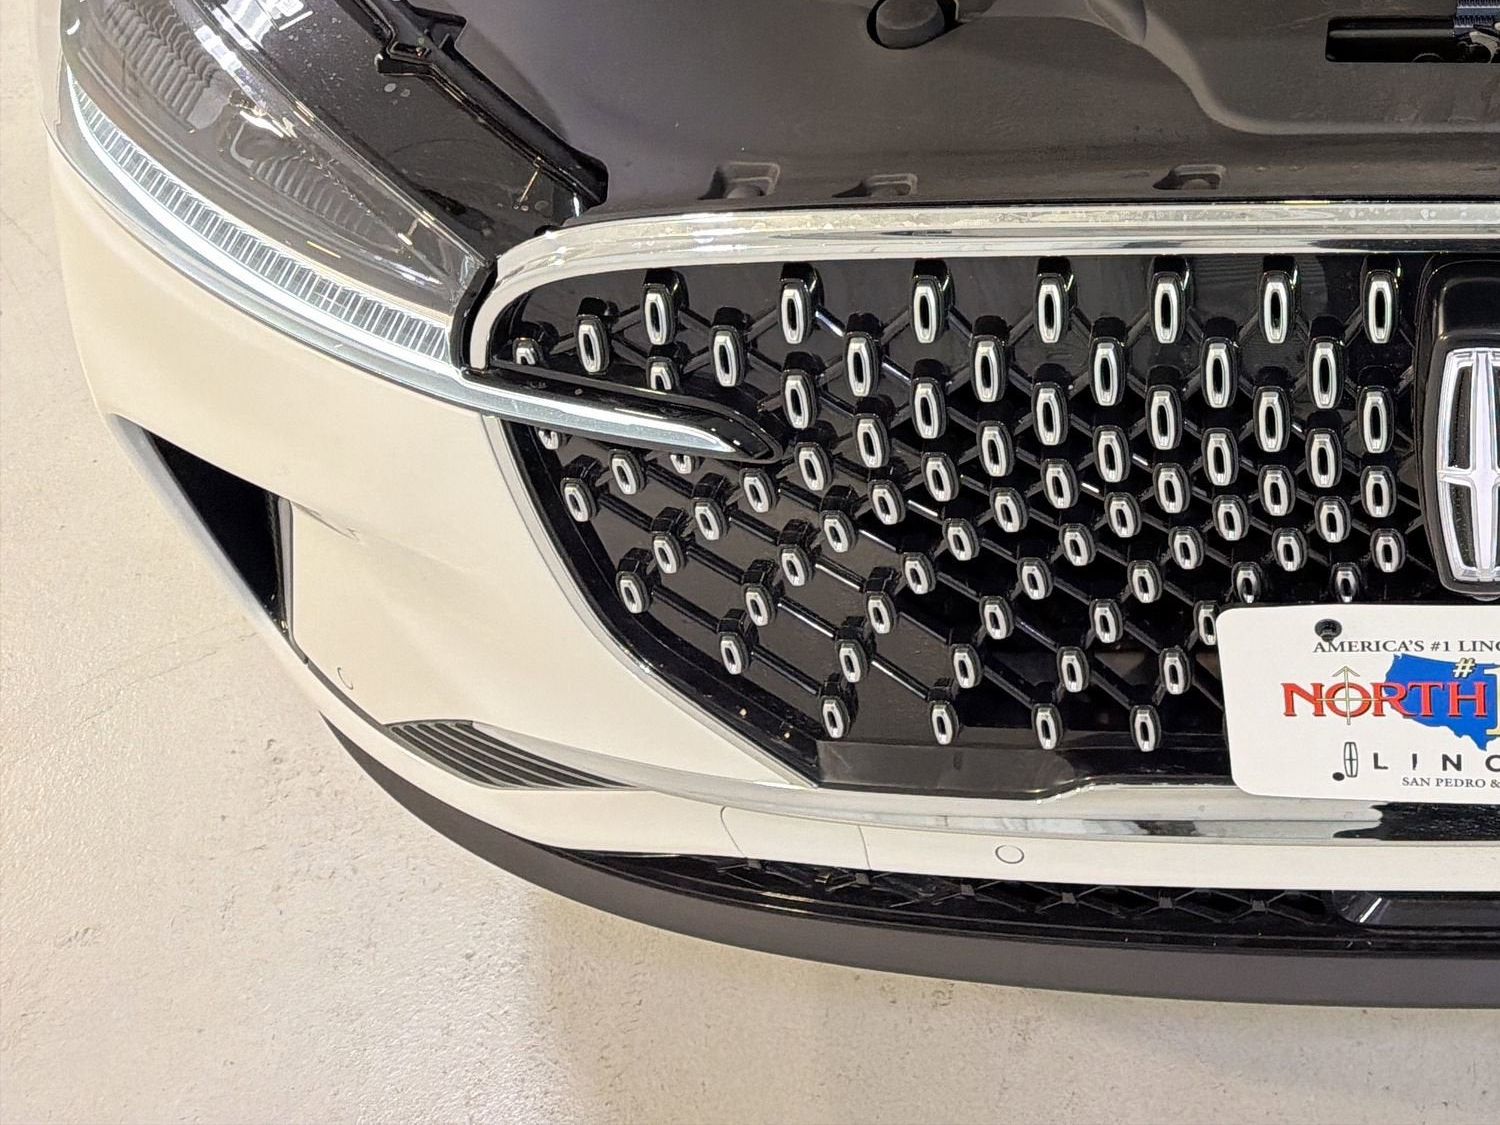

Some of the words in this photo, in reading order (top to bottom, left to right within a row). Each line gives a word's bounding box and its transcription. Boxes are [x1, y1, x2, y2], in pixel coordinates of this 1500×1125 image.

[1312, 639, 1425, 653] AMERICA'S
[1430, 640, 1451, 653] #1
[1281, 681, 1488, 719] NORTH
[1401, 776, 1431, 788] SAN
[1435, 777, 1487, 789] PEDRO
